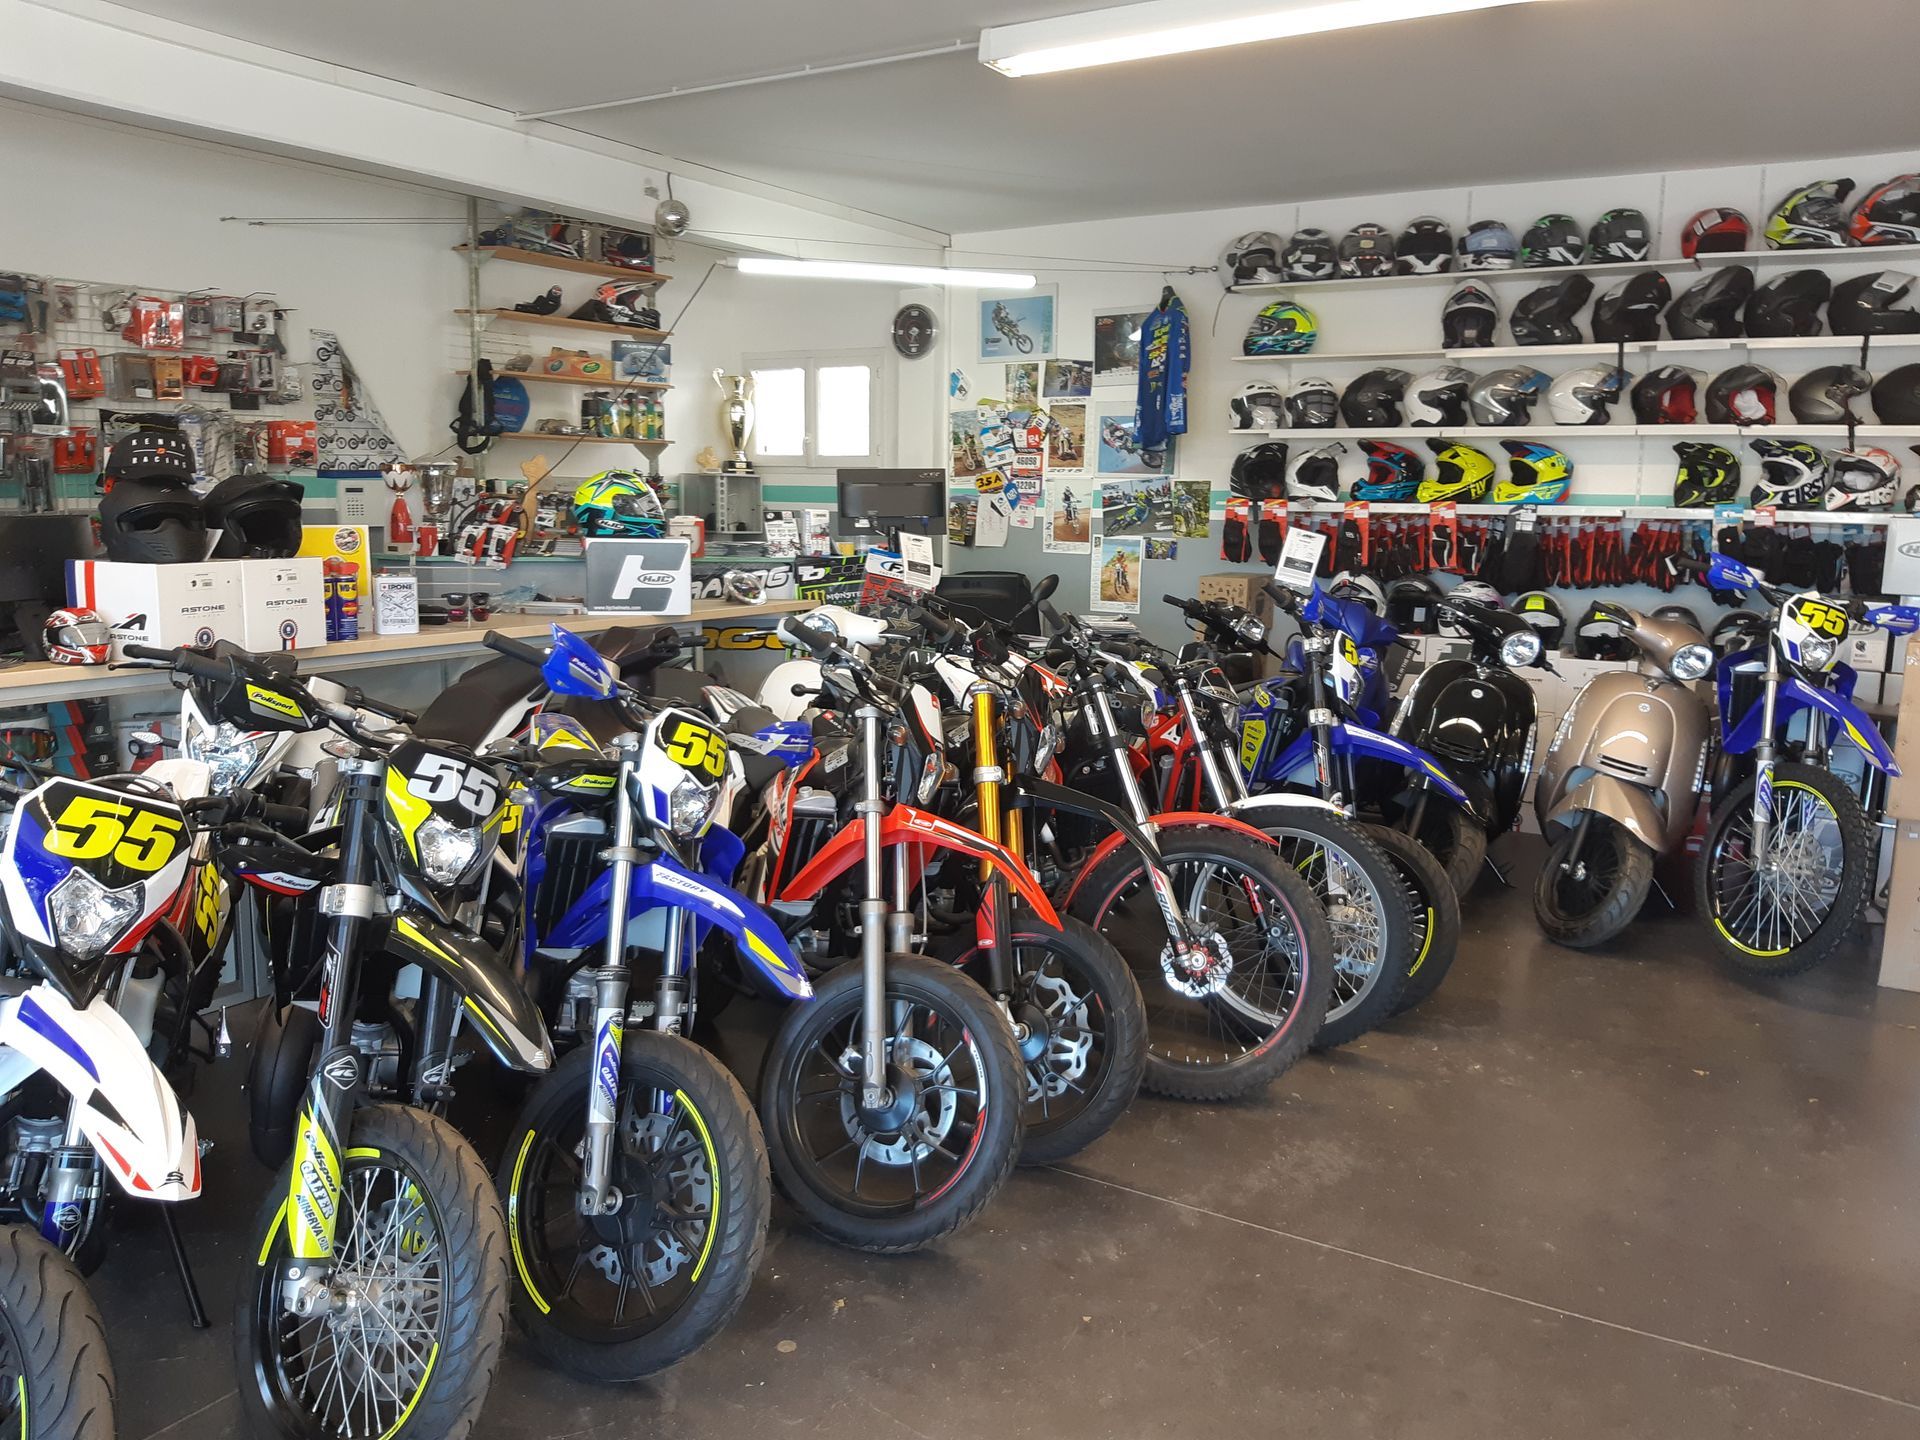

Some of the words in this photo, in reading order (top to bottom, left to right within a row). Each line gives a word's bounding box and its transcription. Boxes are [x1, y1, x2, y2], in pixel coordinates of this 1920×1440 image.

[600, 520, 623, 529] HJC
[642, 574, 671, 583] HJC
[181, 604, 225, 614] ASTONE
[266, 597, 309, 608] ASTONE
[1795, 601, 1847, 637] 55
[252, 692, 294, 711] Polisport
[667, 721, 727, 779] 55
[405, 752, 500, 817] 55
[582, 778, 614, 787] Polisport
[42, 796, 184, 872] 55
[272, 875, 313, 891] Polisport
[655, 871, 708, 894] FACTORY
[304, 1130, 338, 1194] Polisport
[296, 1193, 324, 1238] MINERVA
[317, 1235, 330, 1253] OIL
